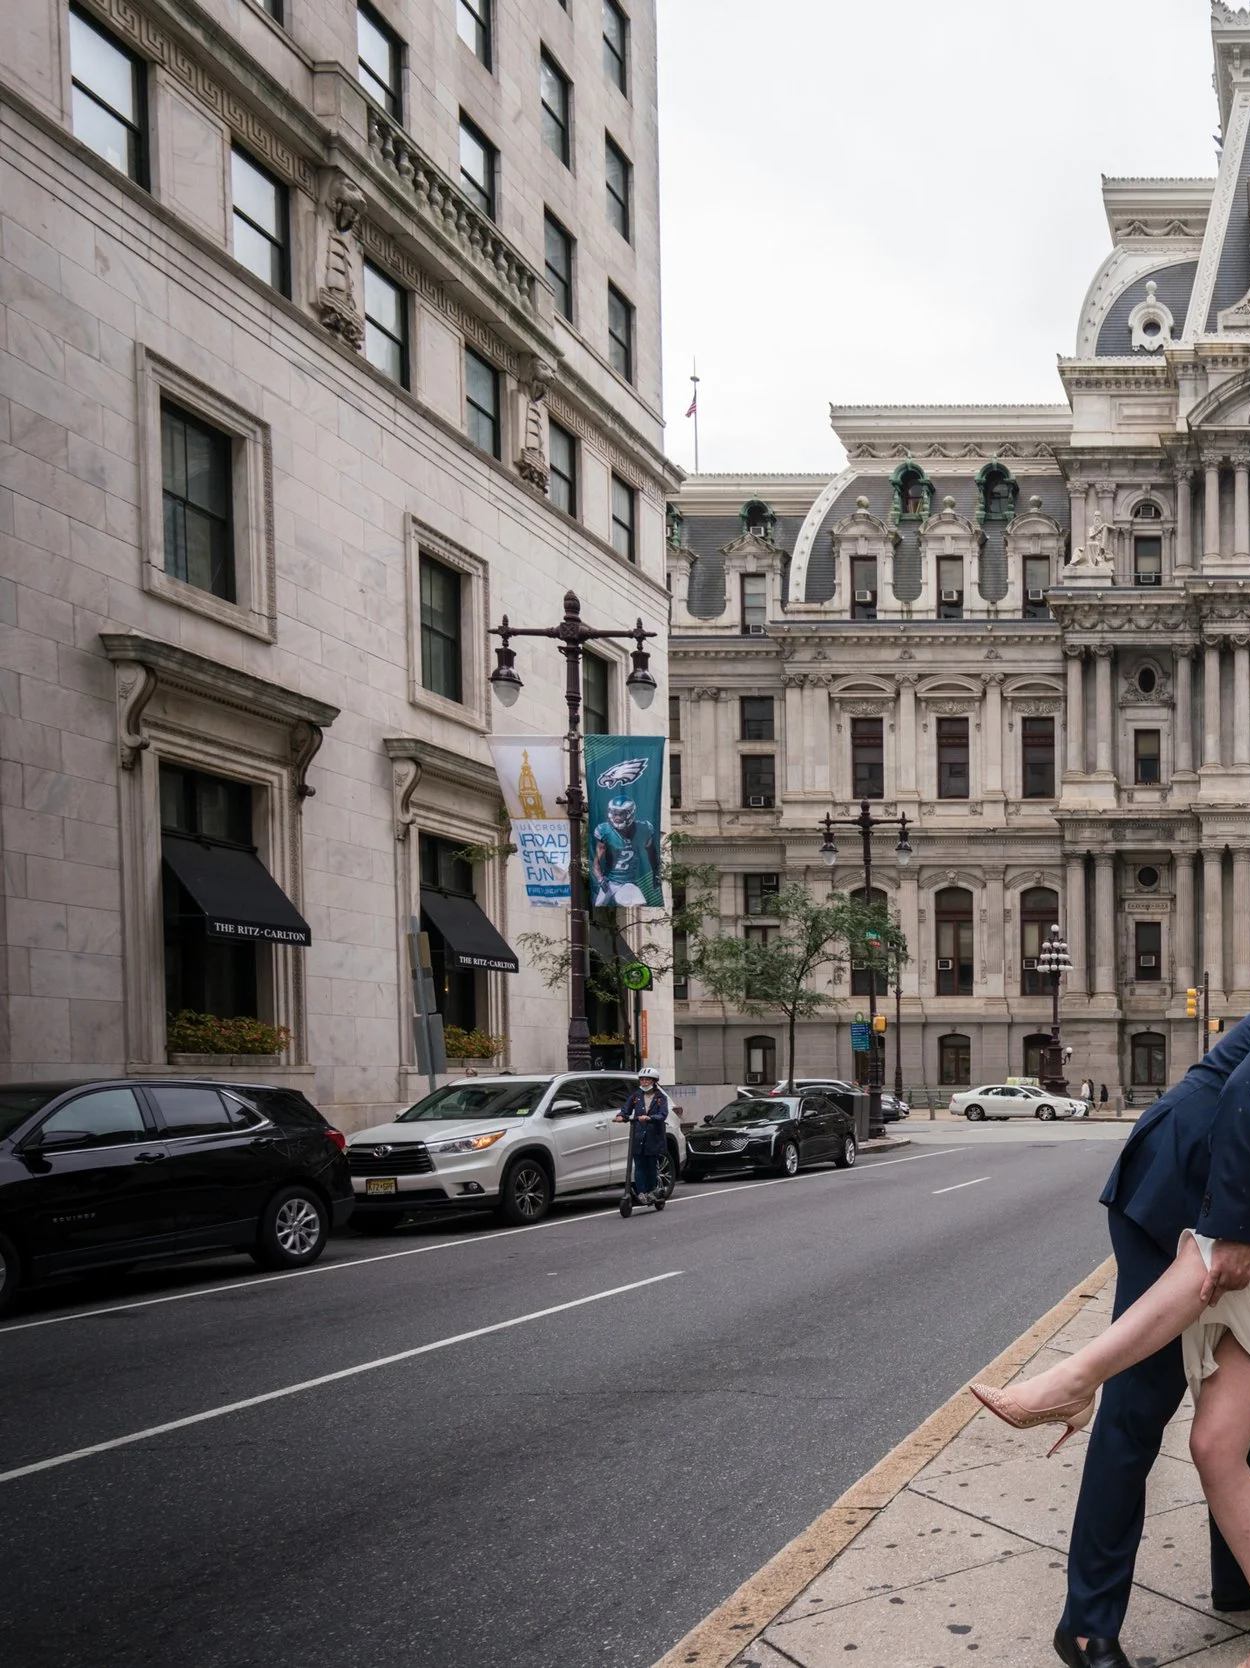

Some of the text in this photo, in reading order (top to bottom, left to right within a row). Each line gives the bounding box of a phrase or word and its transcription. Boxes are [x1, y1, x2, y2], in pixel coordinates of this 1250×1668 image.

[615, 850, 634, 870] 2
[214, 922, 235, 933] THE
[459, 956, 472, 964] THE
